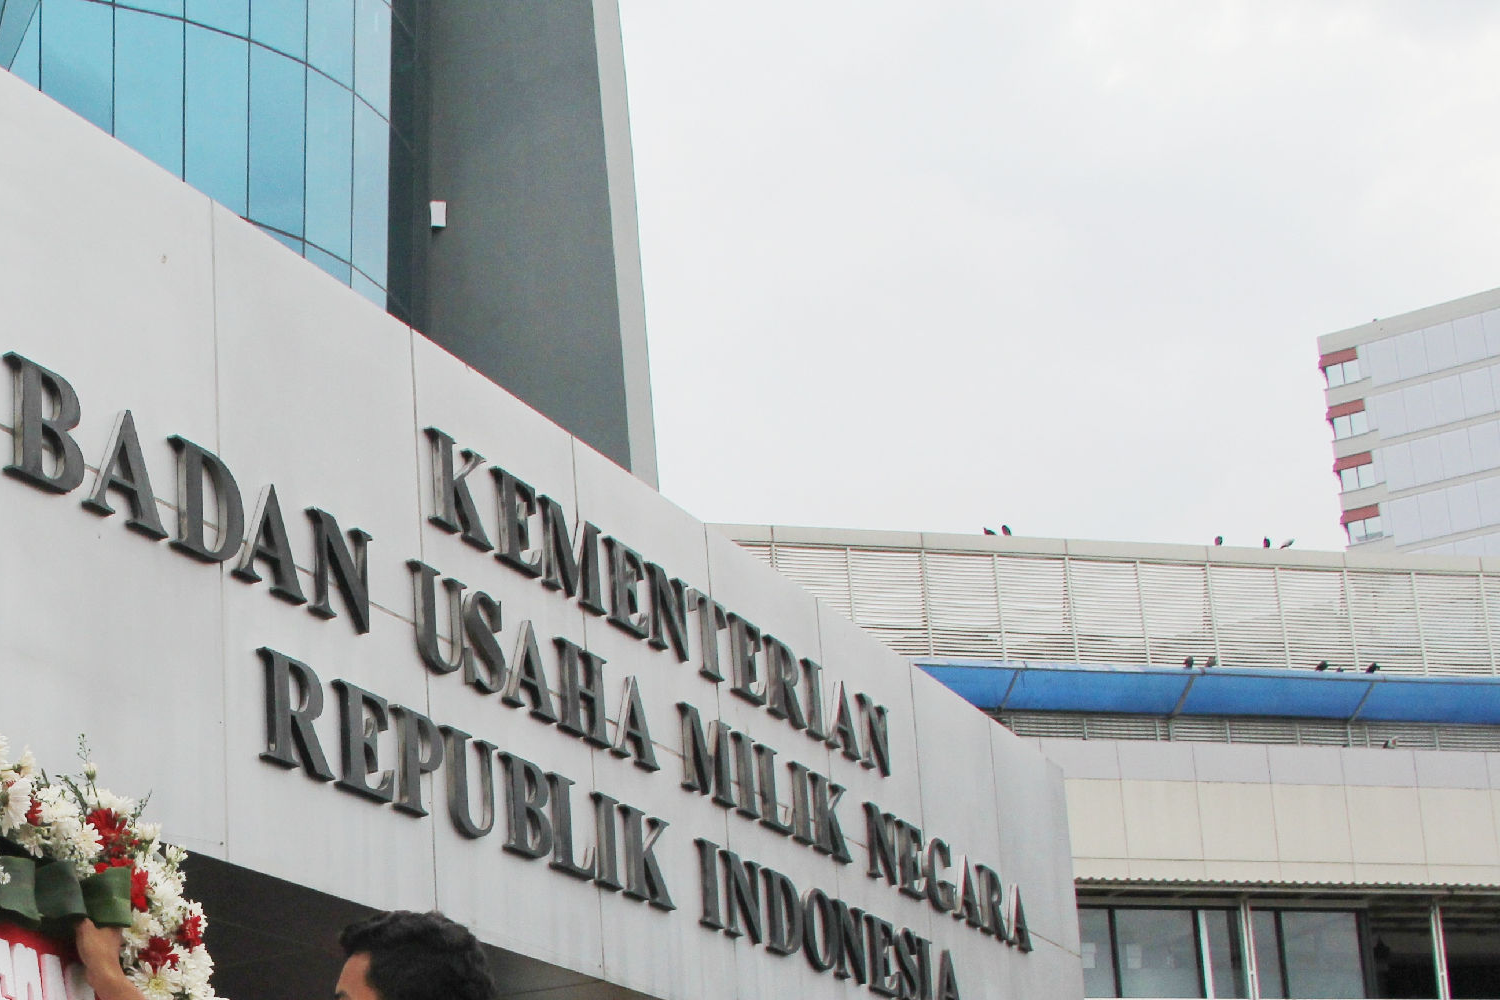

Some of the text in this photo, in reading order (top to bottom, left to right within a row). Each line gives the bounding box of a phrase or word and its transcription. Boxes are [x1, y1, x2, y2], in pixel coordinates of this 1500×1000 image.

[2, 350, 1033, 953] BADAN USAHA MILIK NEGARA
[423, 425, 890, 777] KEMENTERIAN
[256, 645, 676, 911] REPUBLIK
